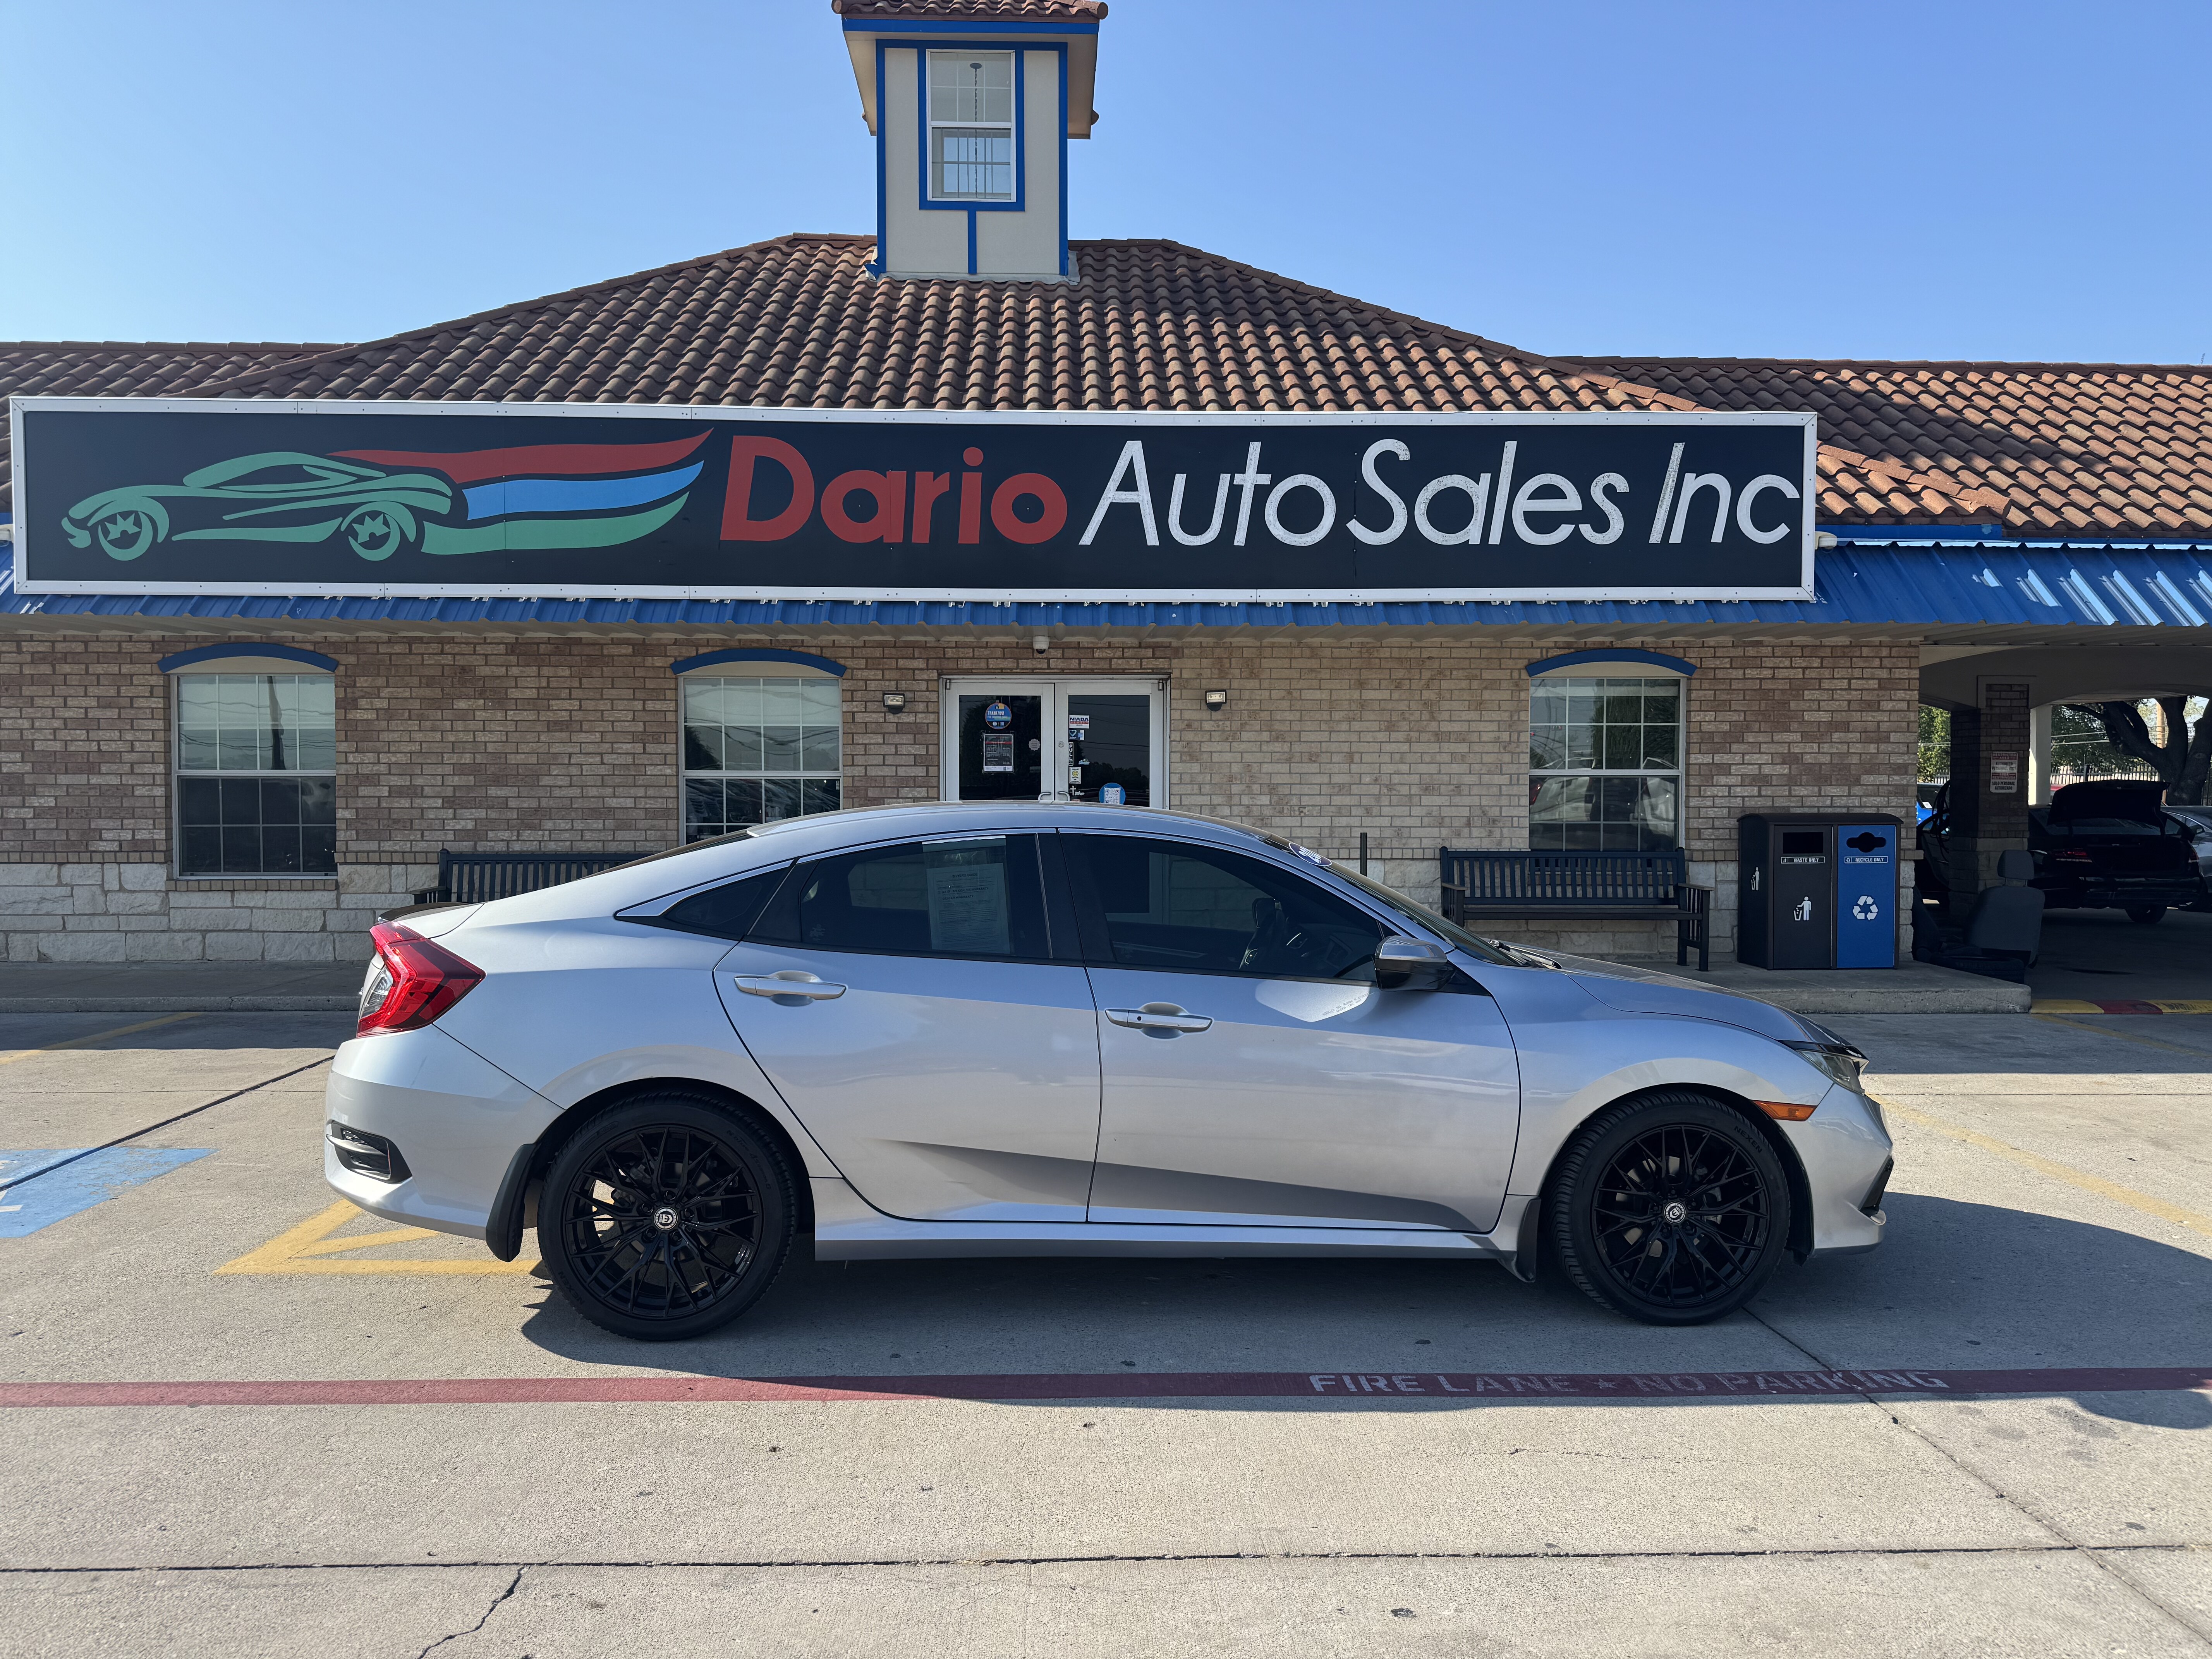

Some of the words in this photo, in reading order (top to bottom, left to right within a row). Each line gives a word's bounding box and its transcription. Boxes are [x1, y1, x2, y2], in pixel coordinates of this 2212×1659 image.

[720, 435, 1067, 544] Dario
[1079, 440, 1336, 547] Auto
[1346, 438, 1630, 545] Sales
[1648, 442, 1800, 544] Inc
[1734, 1125, 1762, 1153] NEXEN
[558, 1271, 586, 1305] NEXEN
[1309, 1375, 1425, 1391] FIRE
[1436, 1375, 1580, 1392] LANE
[1633, 1375, 1706, 1393] NO
[1714, 1370, 1950, 1391] PARKING
